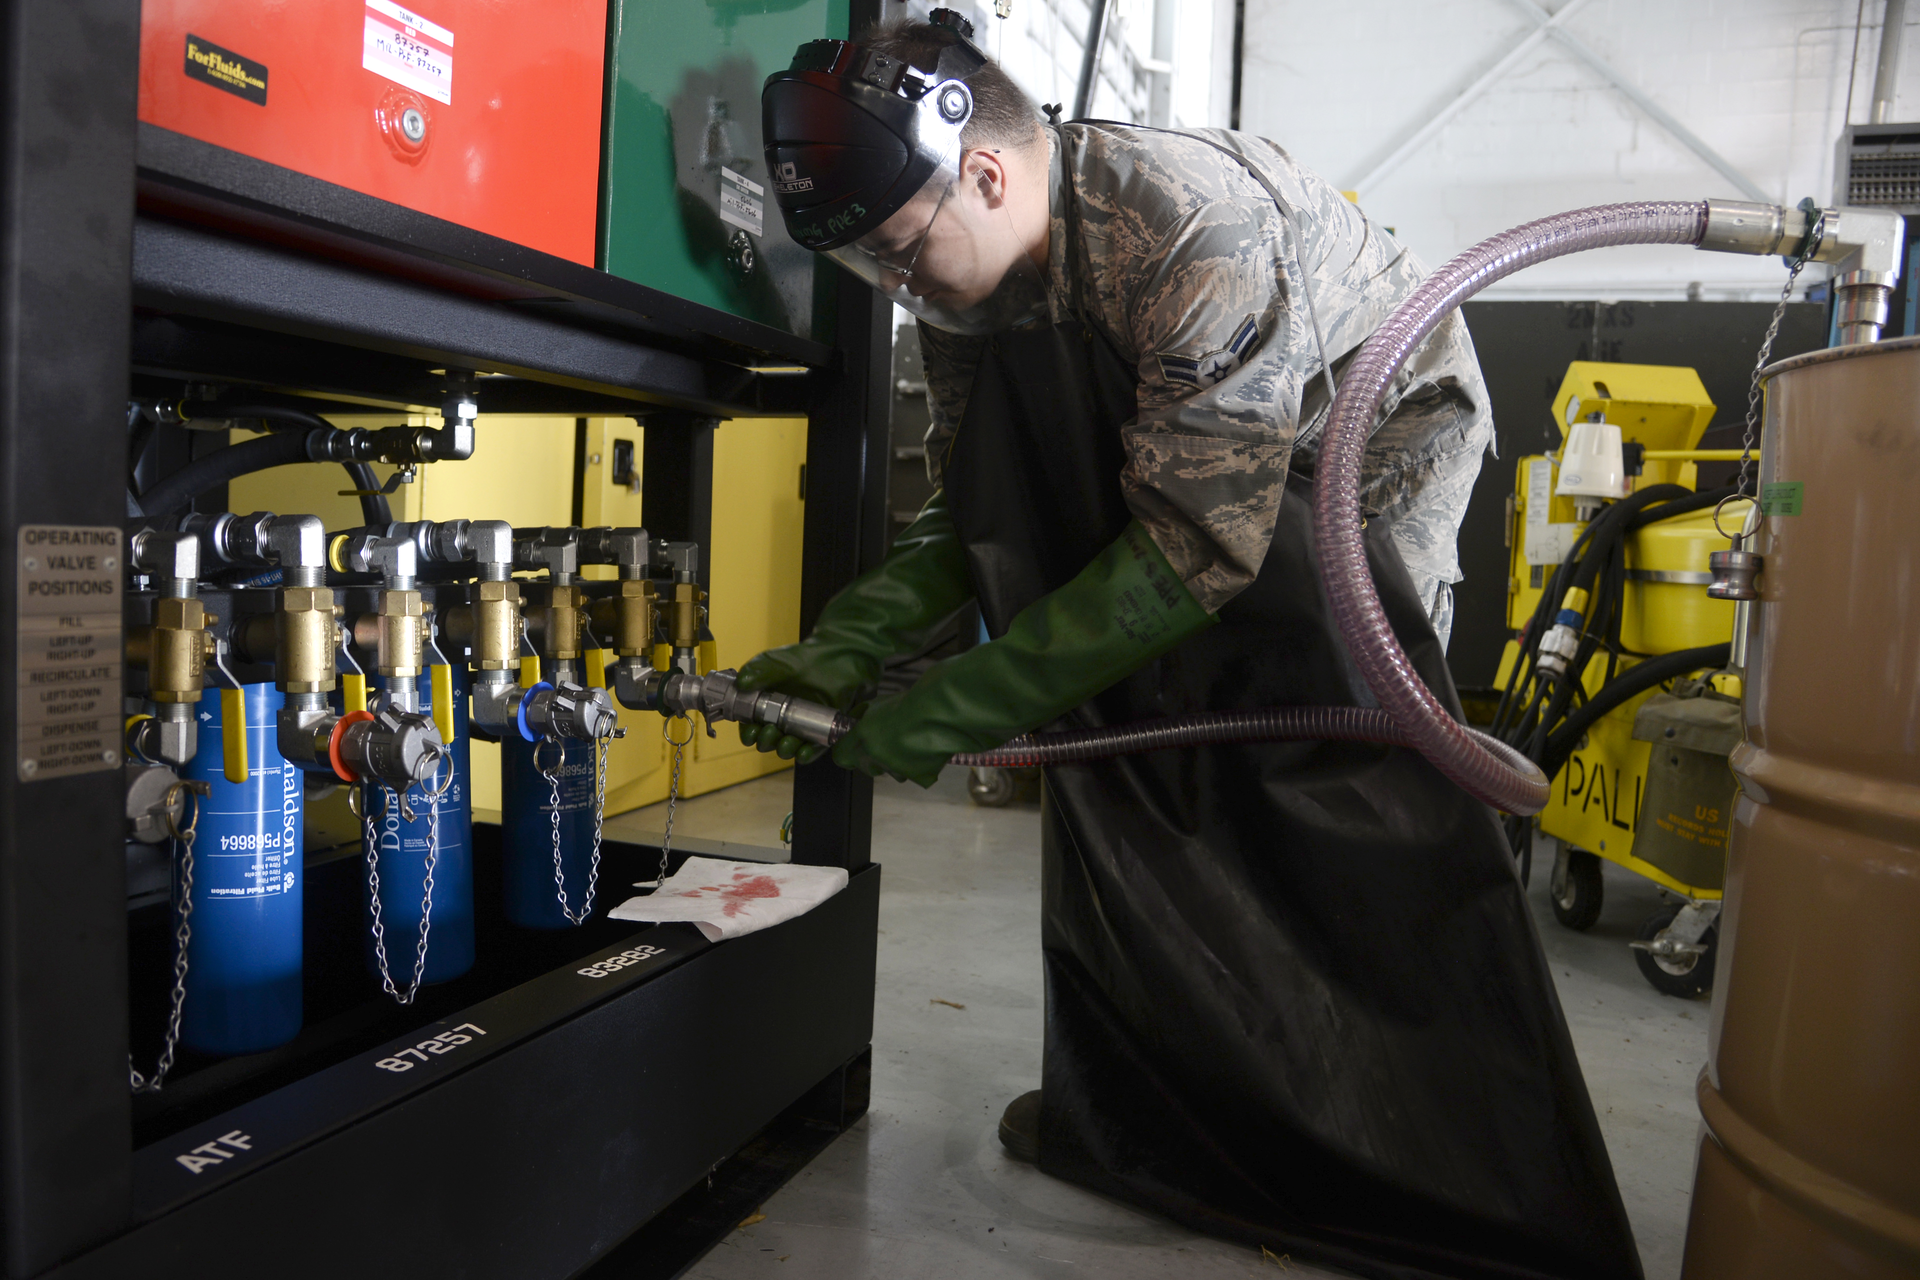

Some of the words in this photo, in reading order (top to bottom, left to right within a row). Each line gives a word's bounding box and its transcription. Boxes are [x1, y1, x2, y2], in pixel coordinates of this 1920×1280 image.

[394, 33, 430, 57] 87257
[187, 43, 266, 90] ForFluids.com
[827, 209, 856, 235] PPE
[850, 202, 867, 218] 3
[25, 529, 116, 546] OPERATING
[46, 556, 96, 571] VALVE
[28, 580, 114, 596] POSITIONS
[59, 616, 83, 628] FILL
[29, 667, 111, 684] RECIRCULATE
[42, 720, 99, 738] DISPENSE
[378, 786, 400, 852] Donal
[1695, 804, 1720, 824] US
[1668, 813, 1706, 834] RECORDS
[1708, 827, 1728, 838] HOL
[220, 831, 281, 851] P568664
[1677, 828, 1696, 841] STAY
[1698, 836, 1722, 847] WITH
[211, 887, 245, 896] Filtration
[247, 886, 265, 894] Fluid
[266, 883, 281, 892] Bulk
[577, 943, 666, 980] 83282
[375, 1022, 488, 1074] 87257
[176, 1129, 254, 1176] ATF
